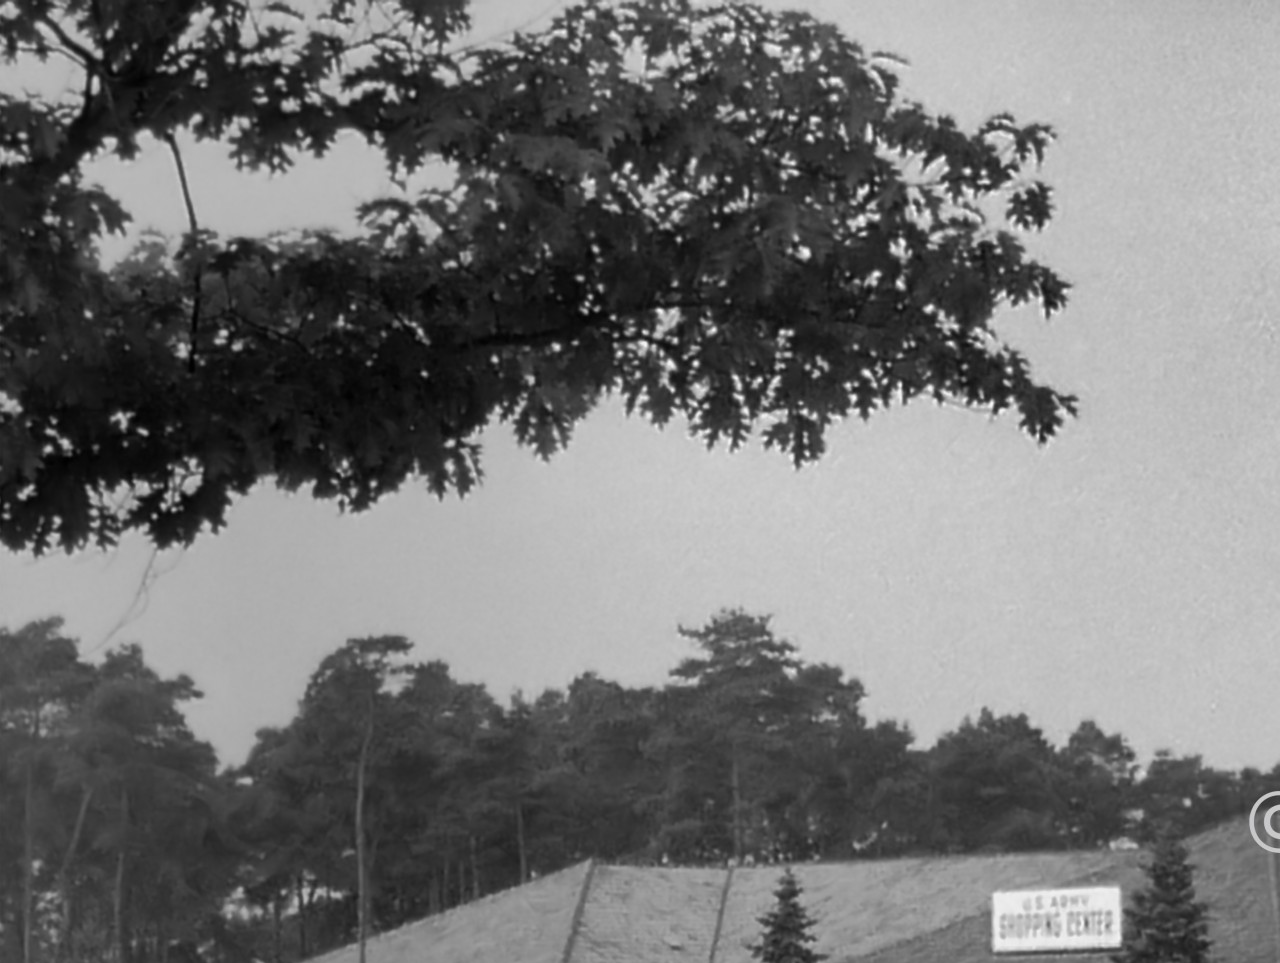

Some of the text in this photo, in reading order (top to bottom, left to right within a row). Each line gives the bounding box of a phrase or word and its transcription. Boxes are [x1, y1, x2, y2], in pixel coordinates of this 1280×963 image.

[1050, 893, 1090, 910] ARMY
[999, 909, 1113, 940] SHOPPING CENTER
